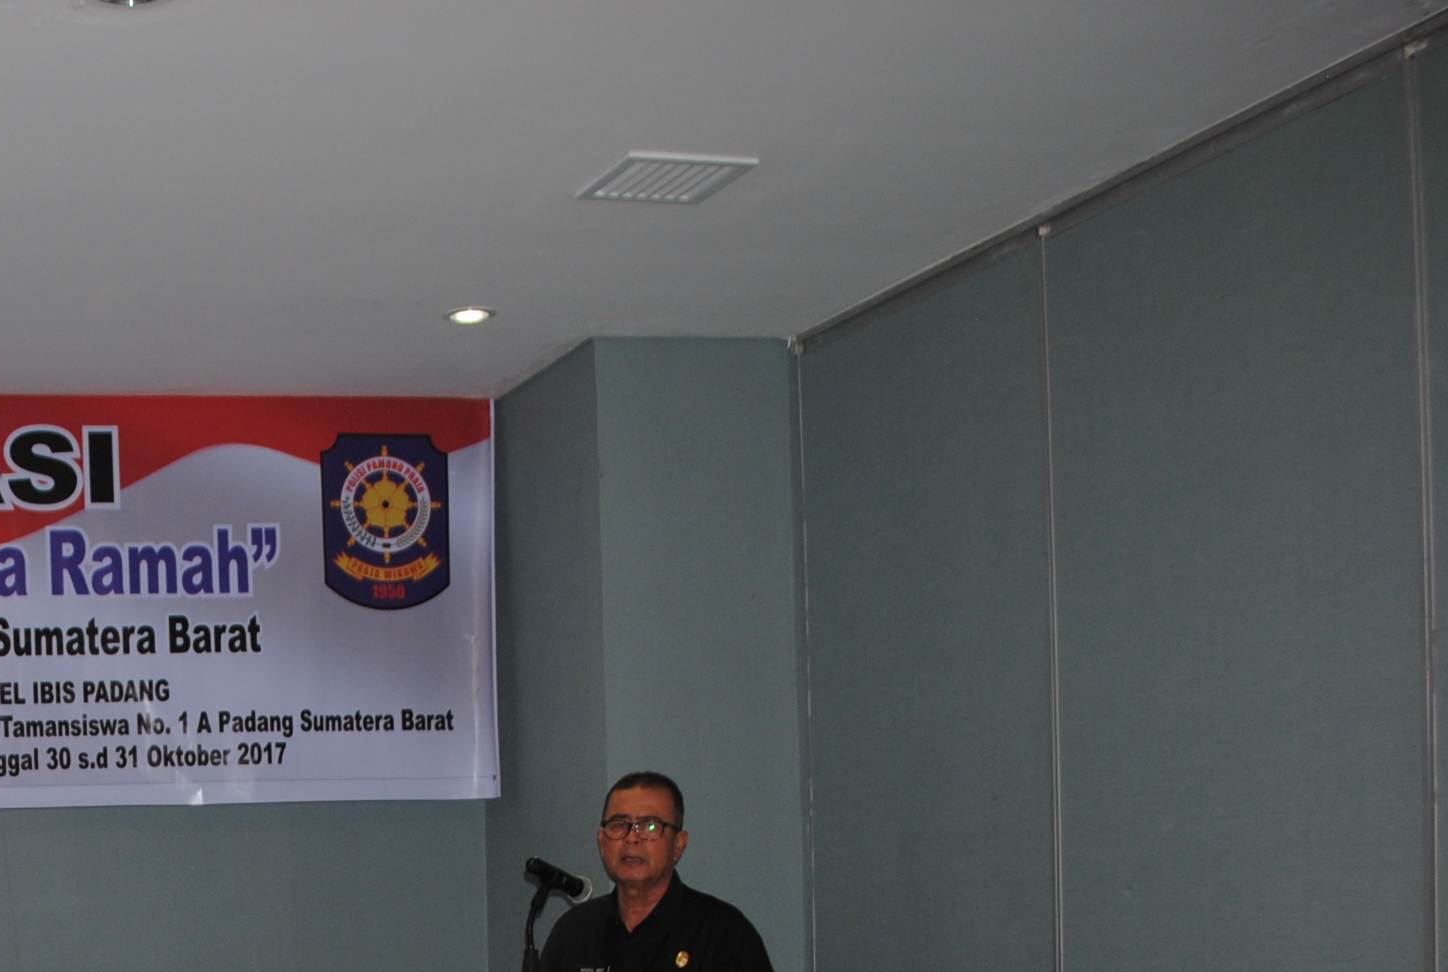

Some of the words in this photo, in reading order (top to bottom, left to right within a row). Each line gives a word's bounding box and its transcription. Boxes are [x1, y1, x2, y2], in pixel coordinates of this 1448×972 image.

[345, 466, 367, 493] POLISI
[403, 467, 426, 494] PRAJA
[167, 614, 262, 654] Barat
[32, 681, 76, 704] IBIS
[82, 679, 170, 703] PADANG
[0, 714, 129, 738] Tamansiswa
[136, 712, 171, 735] No.
[178, 711, 188, 734] 1
[197, 711, 212, 733] A
[218, 710, 294, 738] Padang
[300, 709, 395, 732] Sumatera
[401, 708, 454, 731] Barat
[46, 747, 71, 770] 30
[78, 746, 108, 769] s.d
[115, 745, 138, 768] 31
[147, 744, 231, 768] Oktober
[237, 742, 287, 765] 2017
